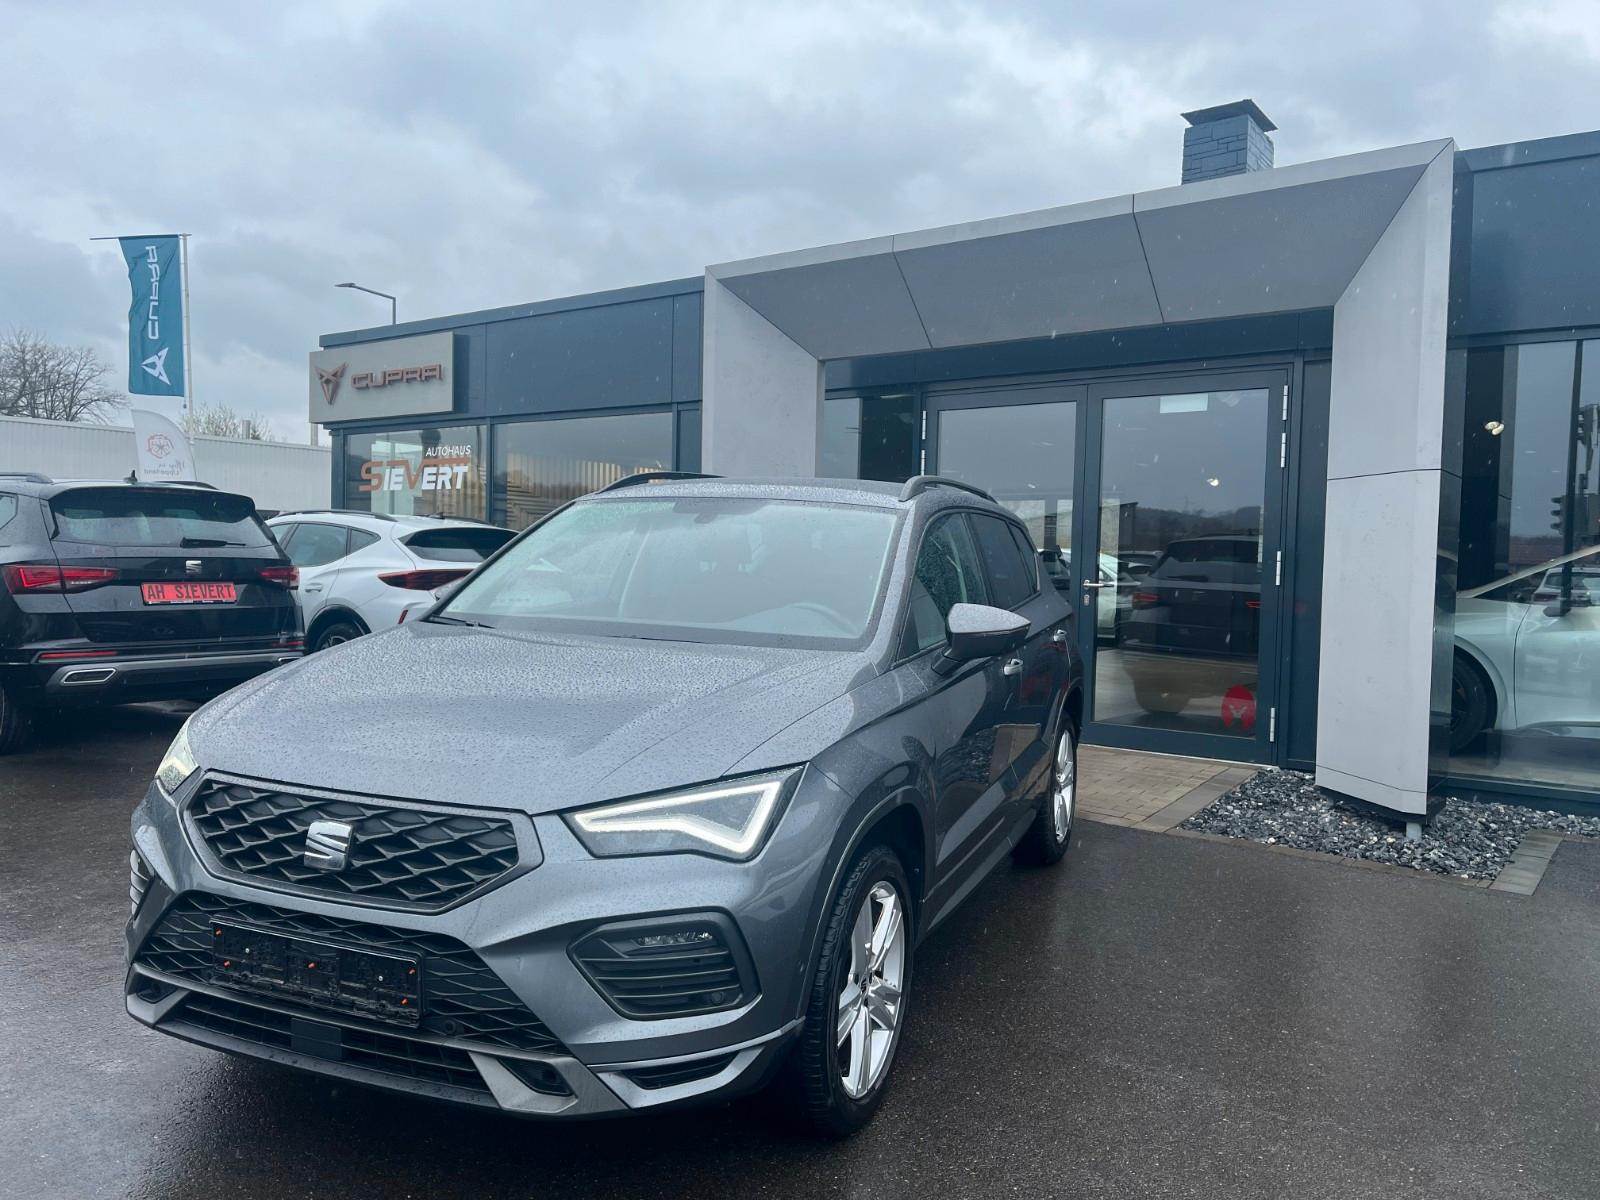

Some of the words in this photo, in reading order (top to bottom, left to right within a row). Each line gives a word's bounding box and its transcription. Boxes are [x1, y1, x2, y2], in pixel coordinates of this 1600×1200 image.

[351, 363, 443, 389] CUPRA
[425, 445, 472, 457] AUTOHAUS
[359, 457, 471, 492] SIEVERT
[147, 585, 166, 600] AH
[175, 584, 233, 599] SIEVERT
